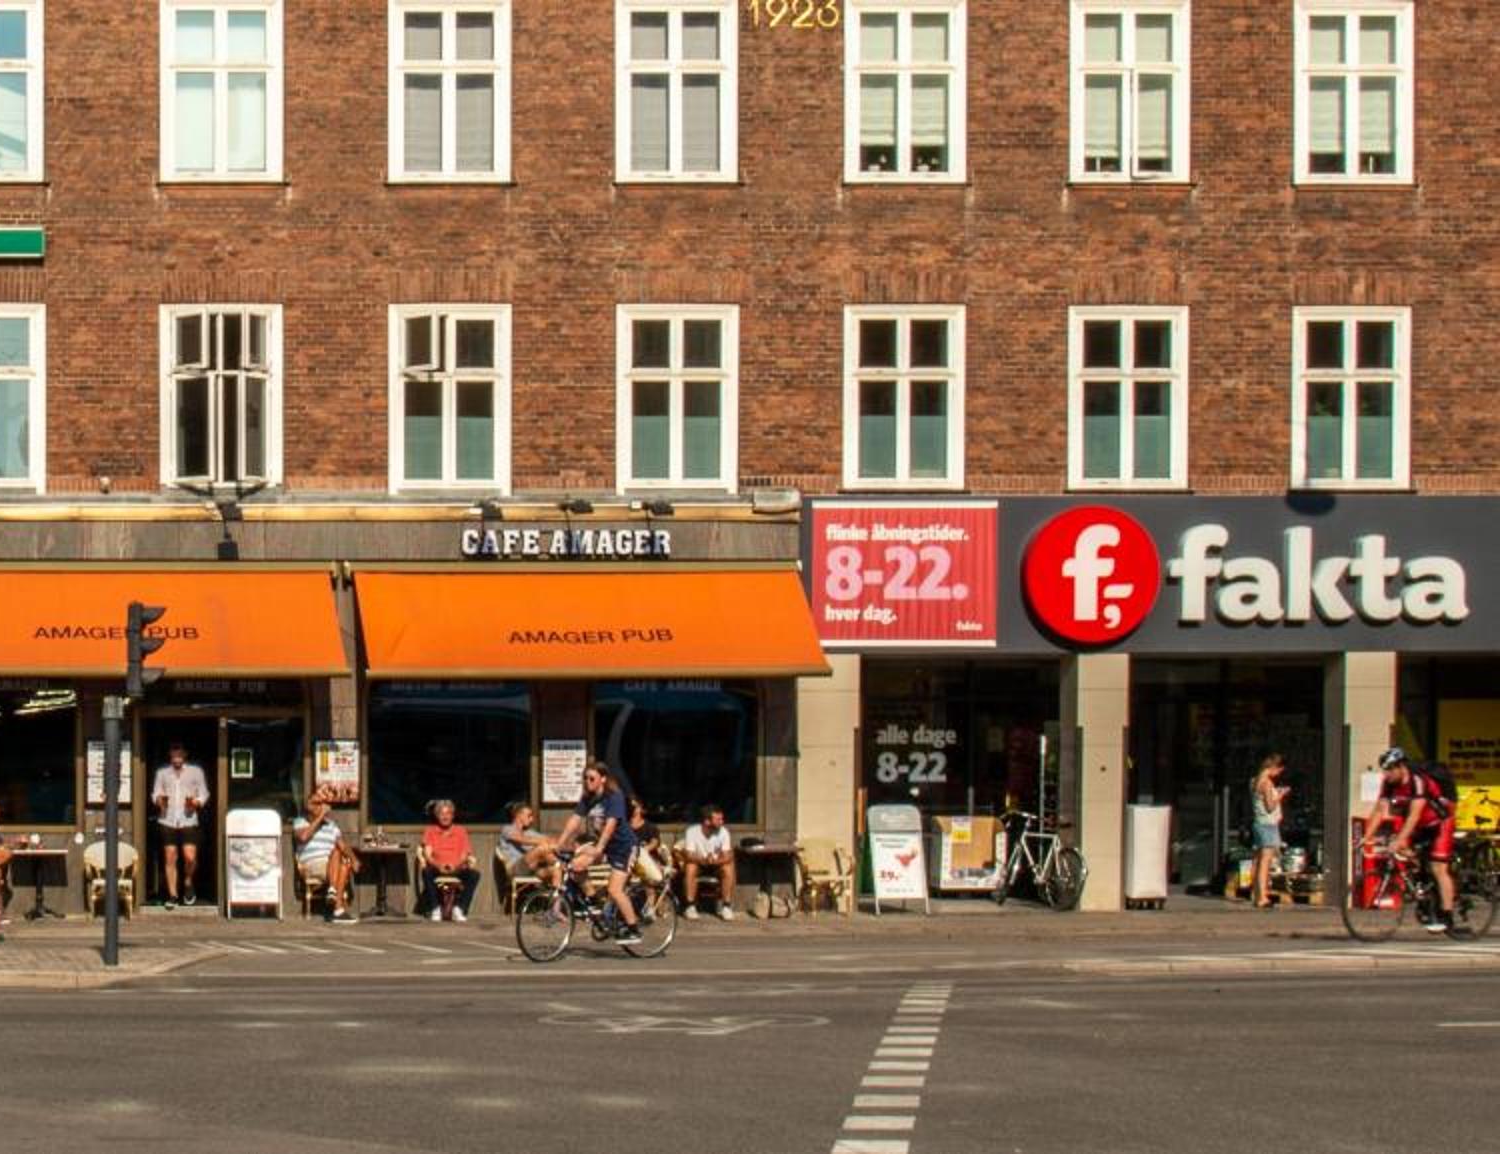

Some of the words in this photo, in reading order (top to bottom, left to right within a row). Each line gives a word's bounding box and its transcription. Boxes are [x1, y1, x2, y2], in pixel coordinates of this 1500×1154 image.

[462, 529, 540, 555] CAFE
[549, 529, 671, 555] AMAGER
[826, 522, 868, 541] flinke
[825, 545, 969, 601] 8-22.
[1166, 523, 1470, 624] fakta
[825, 604, 860, 621] hver
[863, 604, 898, 625] dag.
[34, 626, 132, 639] AMAGE
[148, 626, 199, 640] PUB
[508, 629, 615, 645] AMAGER
[621, 628, 673, 642] PUB
[876, 724, 908, 744] alle
[912, 724, 957, 748] dage
[876, 751, 947, 783] 8-22
